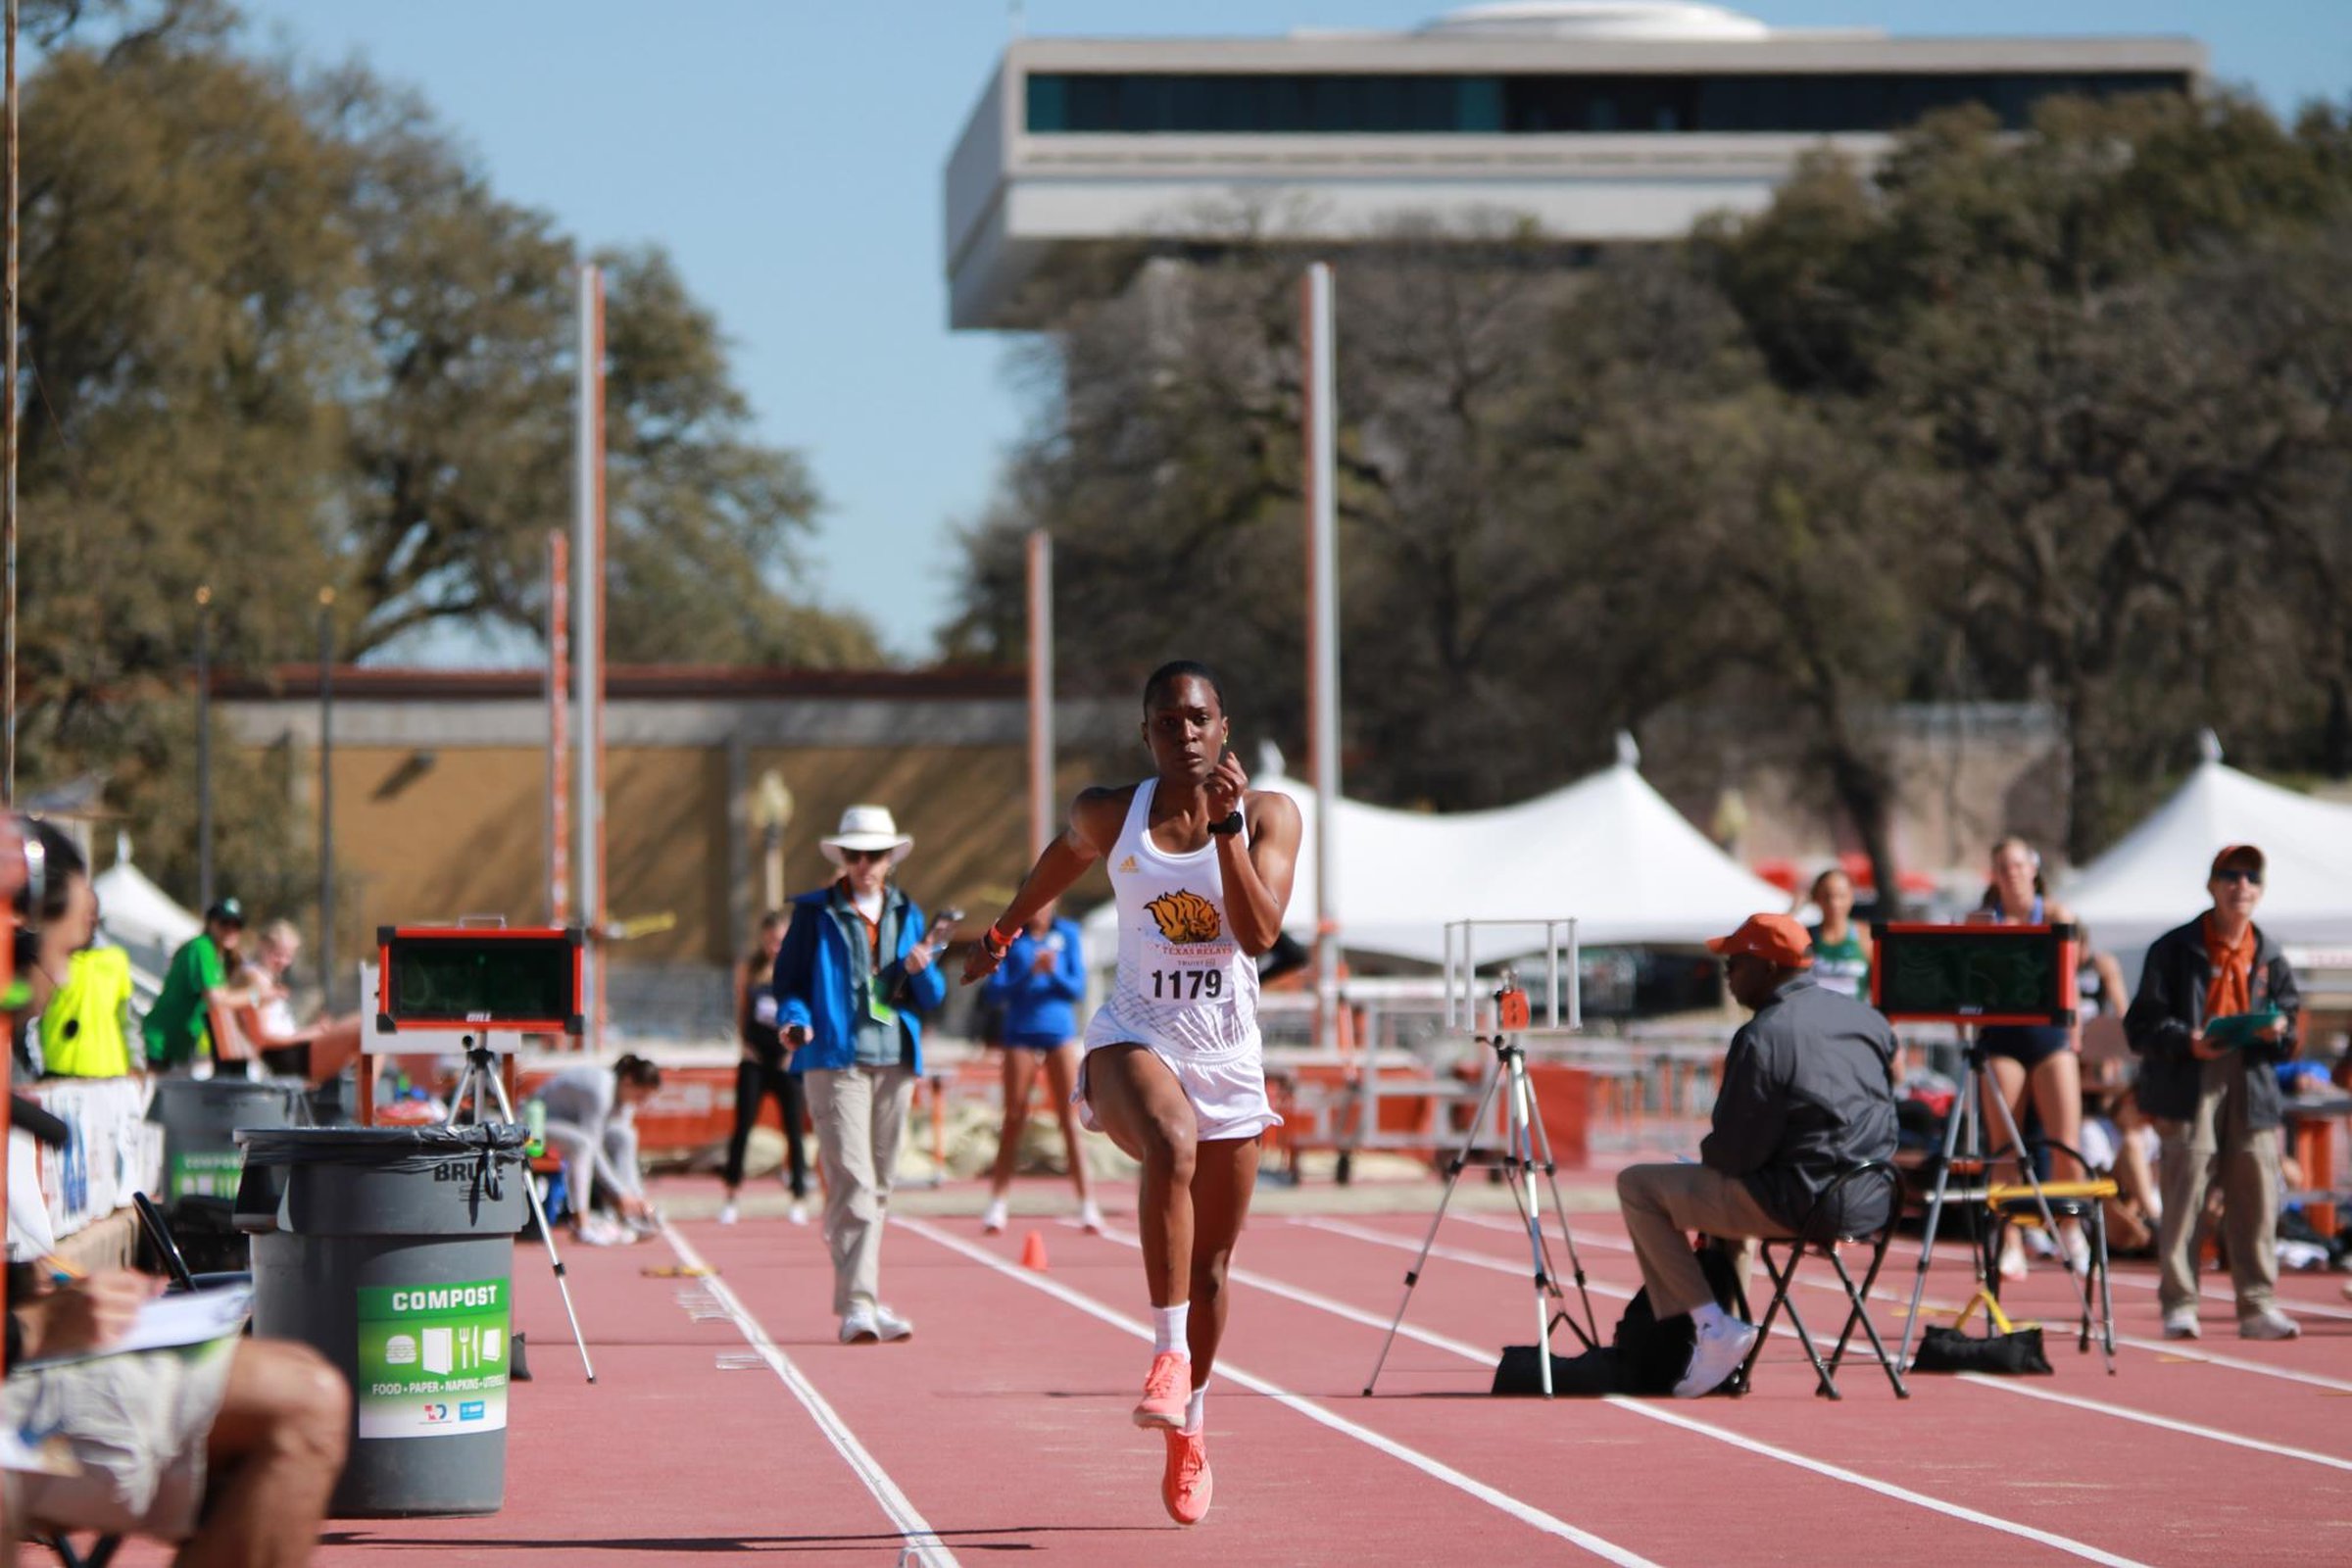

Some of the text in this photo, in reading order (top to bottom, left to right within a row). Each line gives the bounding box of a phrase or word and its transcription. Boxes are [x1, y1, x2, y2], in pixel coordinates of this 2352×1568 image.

[1163, 947, 1233, 956] TEXAS RELAYS
[1152, 969, 1222, 1000] 1179
[392, 1286, 498, 1311] COMPOST
[372, 1383, 402, 1395] FOOD
[410, 1381, 439, 1394] PAPER
[446, 1378, 479, 1392] NAPKINS
